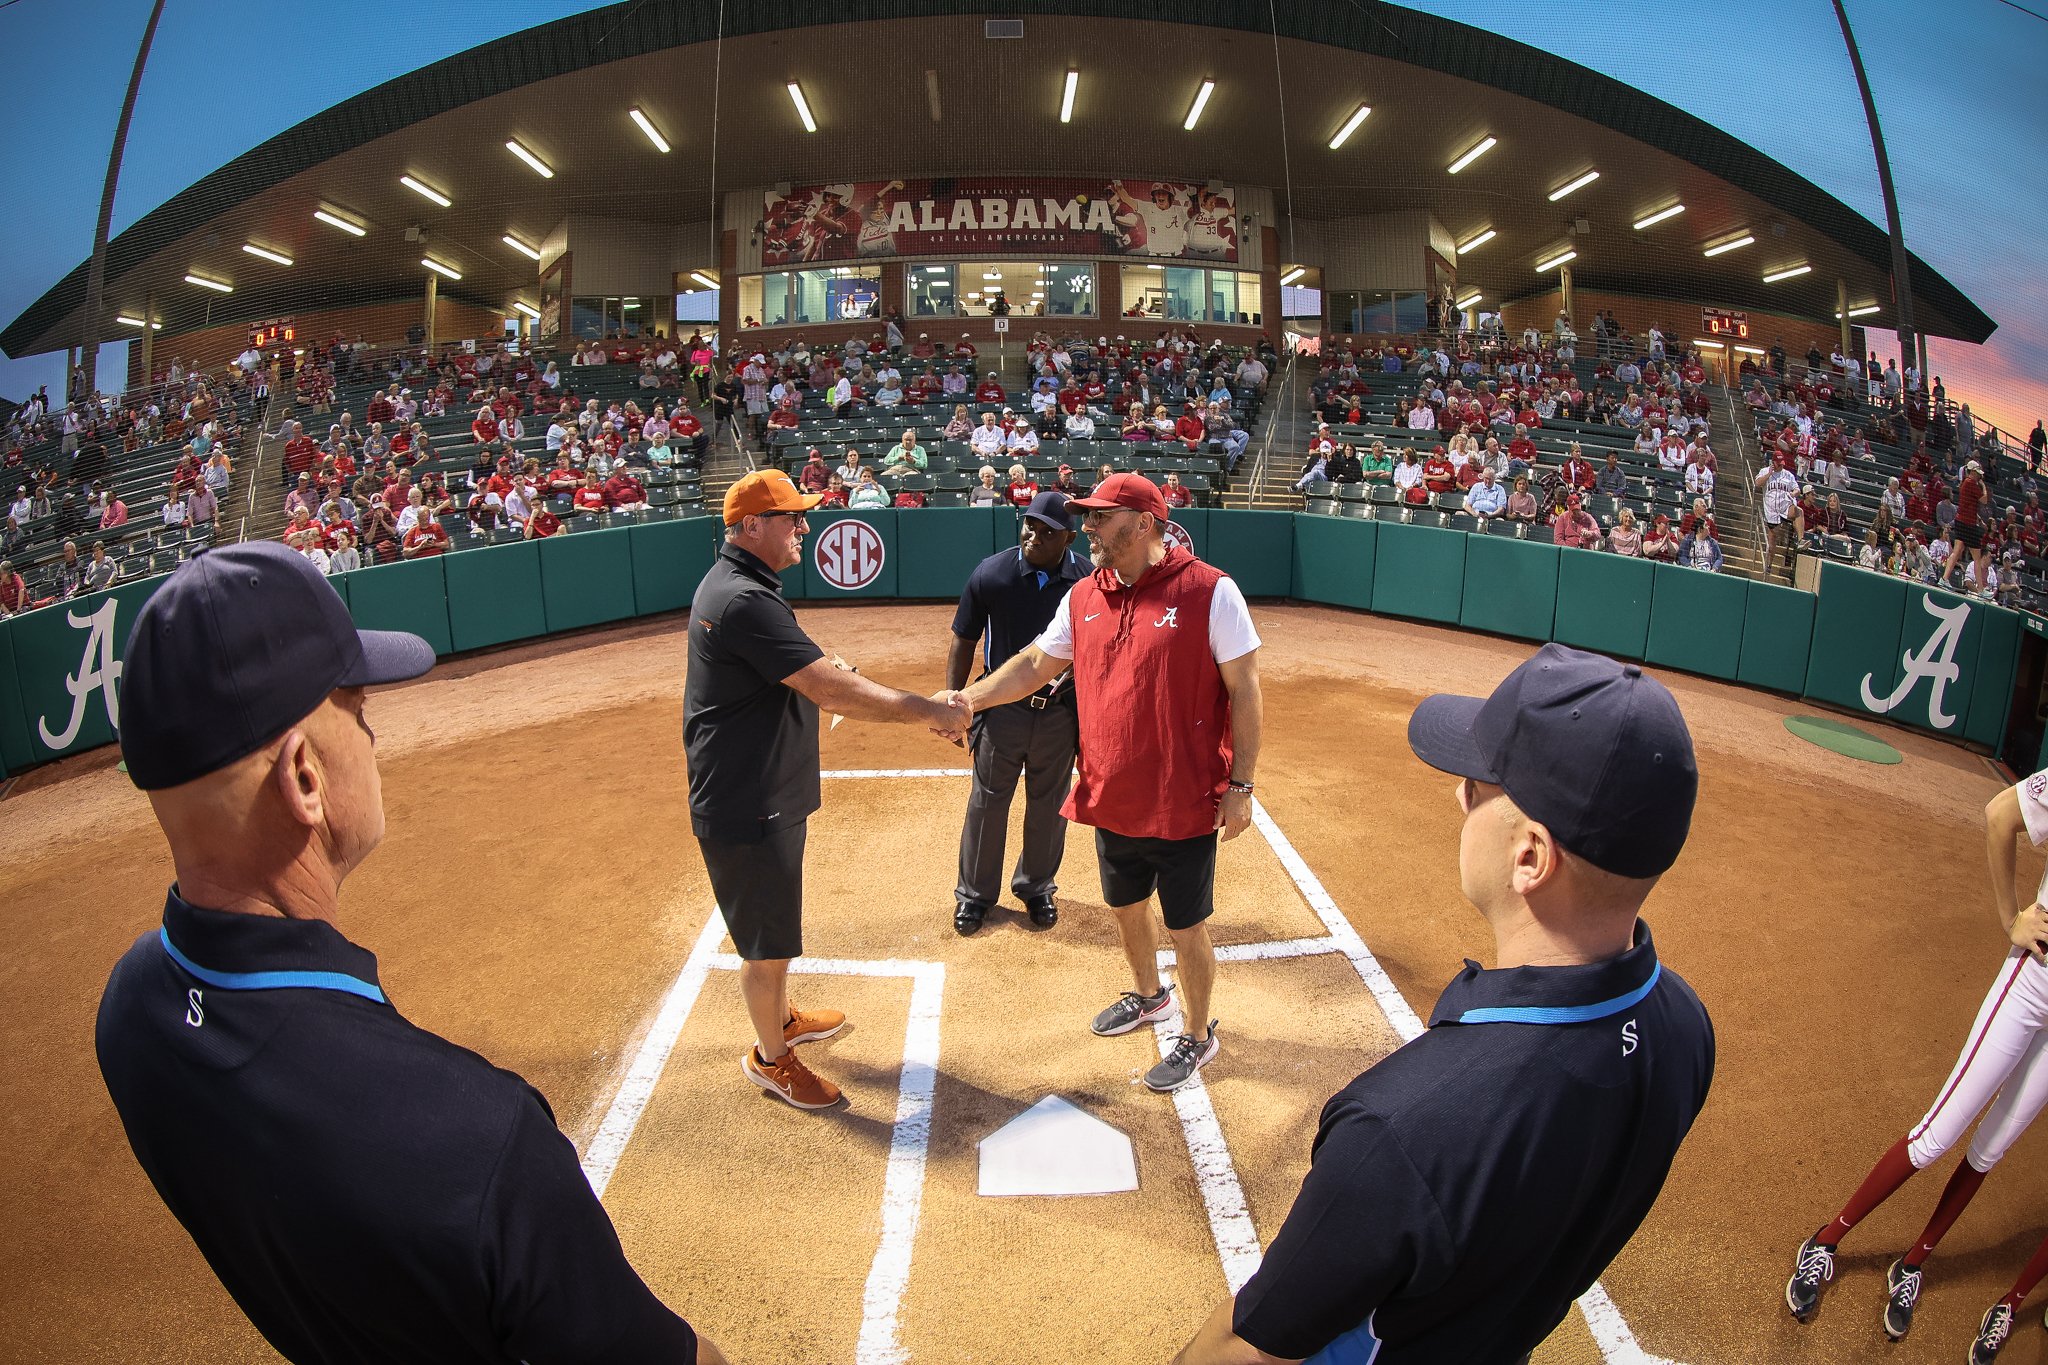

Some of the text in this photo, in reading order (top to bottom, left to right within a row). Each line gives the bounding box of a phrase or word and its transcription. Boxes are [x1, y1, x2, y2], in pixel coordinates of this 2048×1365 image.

[888, 198, 1115, 232] ALABAMA
[1206, 226, 1216, 234] 33
[998, 321, 1005, 329] D
[1712, 320, 1718, 332] 0
[1740, 325, 1746, 336] 0
[256, 334, 264, 345] 0
[465, 342, 472, 350] C
[111, 397, 118, 405] B
[821, 525, 877, 584] SEC
[1154, 607, 1178, 628] A
[1860, 592, 1959, 728] A
[38, 597, 123, 749] A
[186, 988, 204, 1027] S
[1621, 1018, 1639, 1056] S
